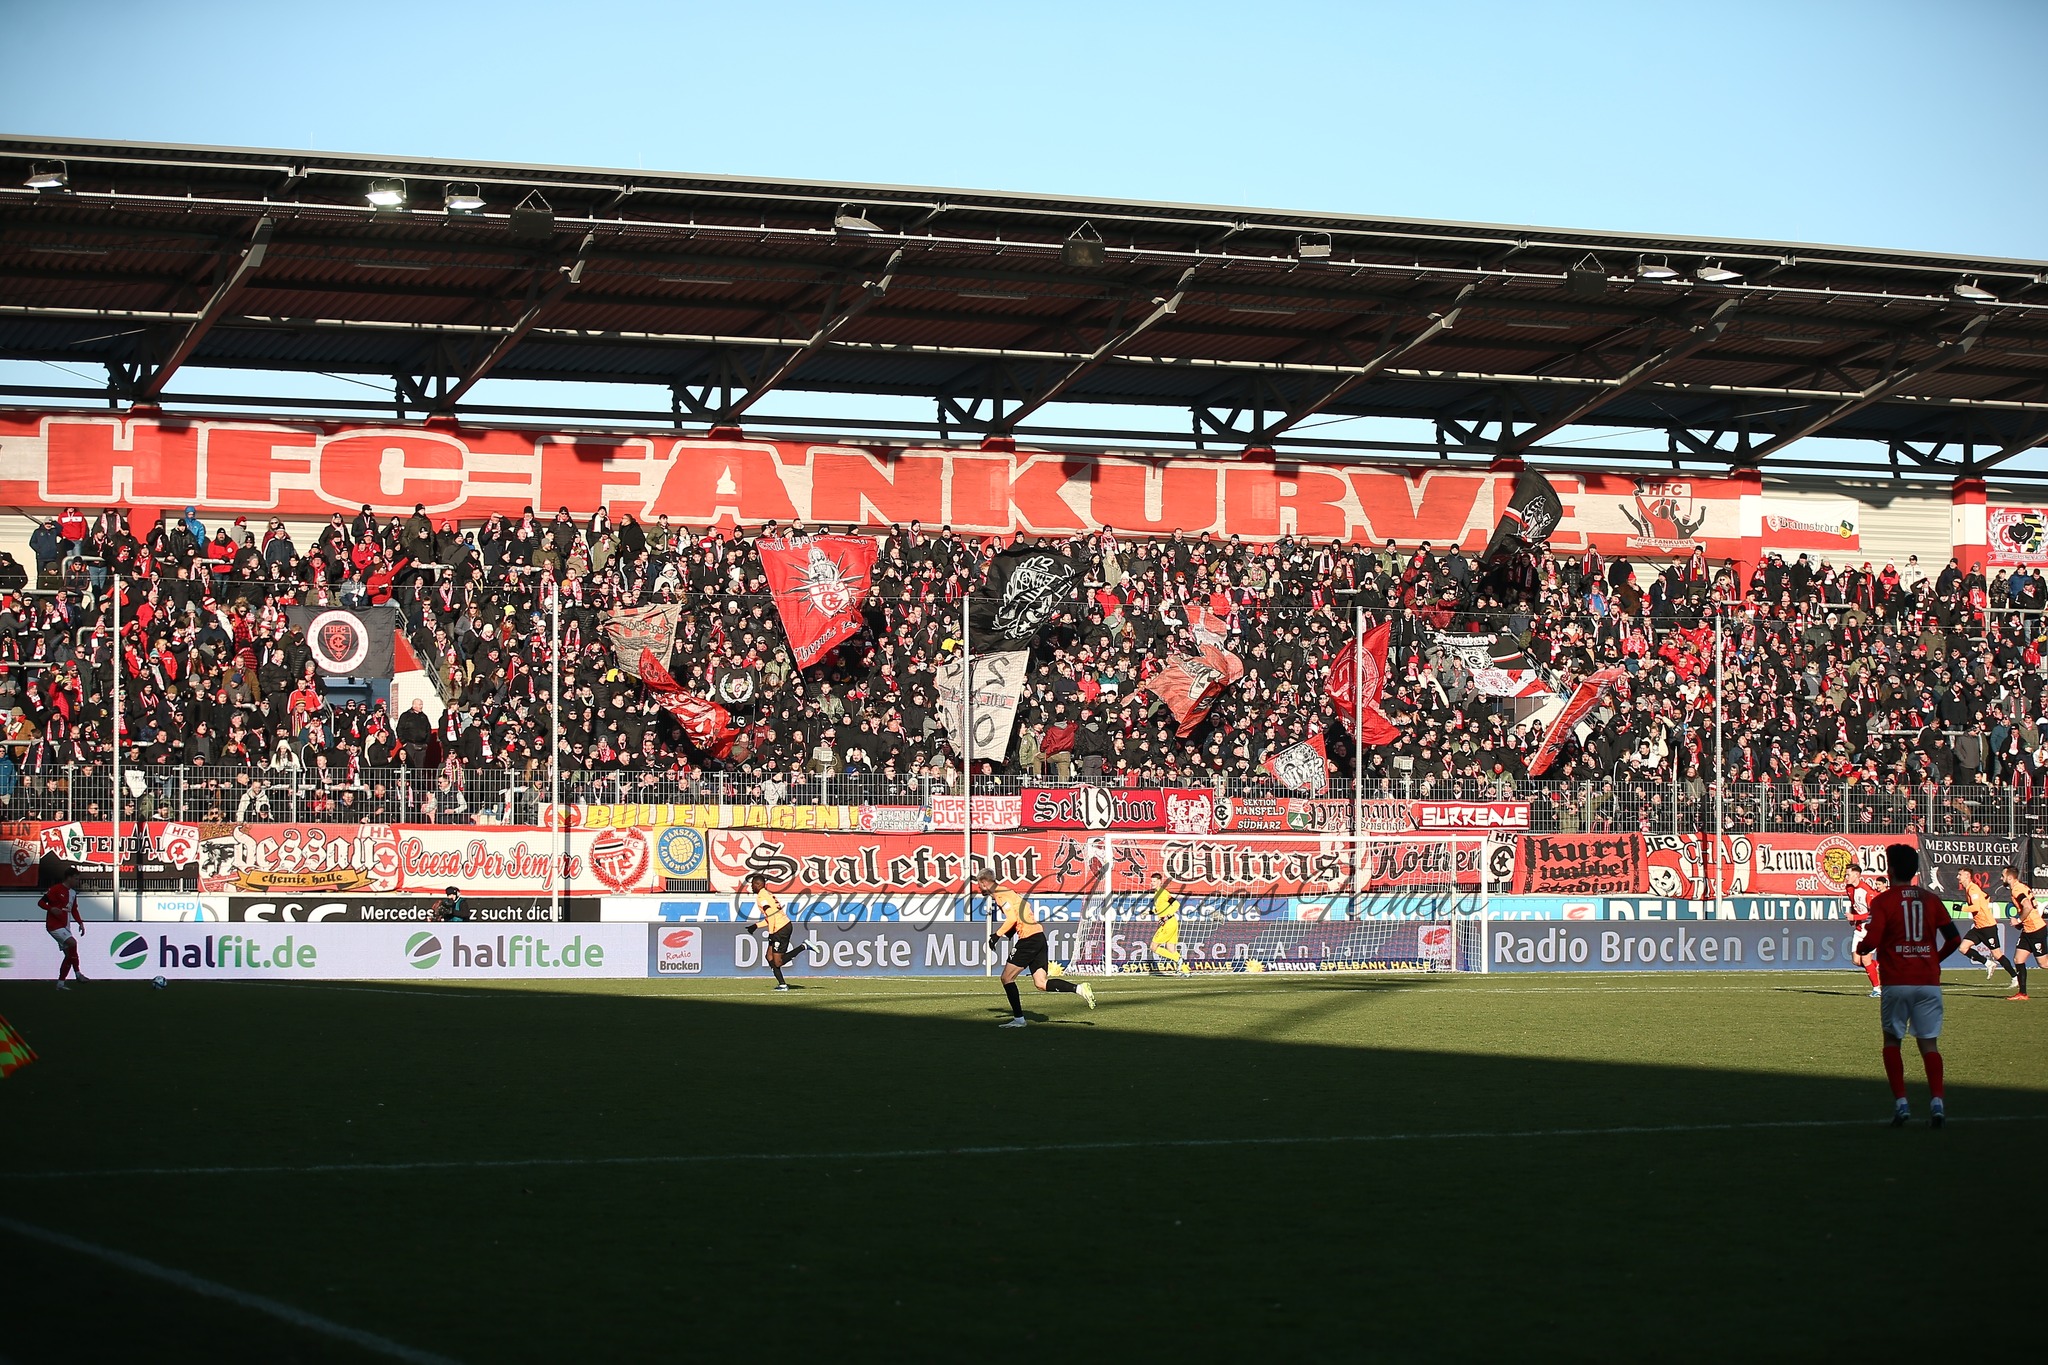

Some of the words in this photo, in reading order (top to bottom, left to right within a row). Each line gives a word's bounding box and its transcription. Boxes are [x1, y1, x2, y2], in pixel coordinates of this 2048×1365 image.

[1649, 483, 1684, 497] HFC
[1235, 806, 1285, 816] MANSFELD
[1422, 806, 1528, 826] SURREALE
[1237, 818, 1281, 829] SÜDHARZ
[172, 826, 196, 838] HFC
[1495, 832, 1518, 844] HFC
[17, 840, 34, 851] HFC
[70, 835, 166, 854] STENDAL
[1925, 838, 2020, 853] MERSEBURGER
[464, 838, 505, 880] Per
[1933, 852, 2011, 866] DOMFALKEN
[157, 902, 195, 911] NORD
[481, 905, 523, 920] sucht
[1901, 900, 1923, 942] 10
[159, 935, 317, 968] halfit.de
[452, 935, 604, 968] halfit.de
[809, 929, 911, 968] beste
[1494, 927, 1588, 963] Radio
[1600, 927, 1742, 963] Brocken
[666, 950, 692, 960] Radio
[659, 960, 700, 971] Brocken
[1194, 960, 1233, 971] HALLE
[1267, 961, 1317, 971] MERKUR
[1320, 961, 1387, 971] SPIELBANK
